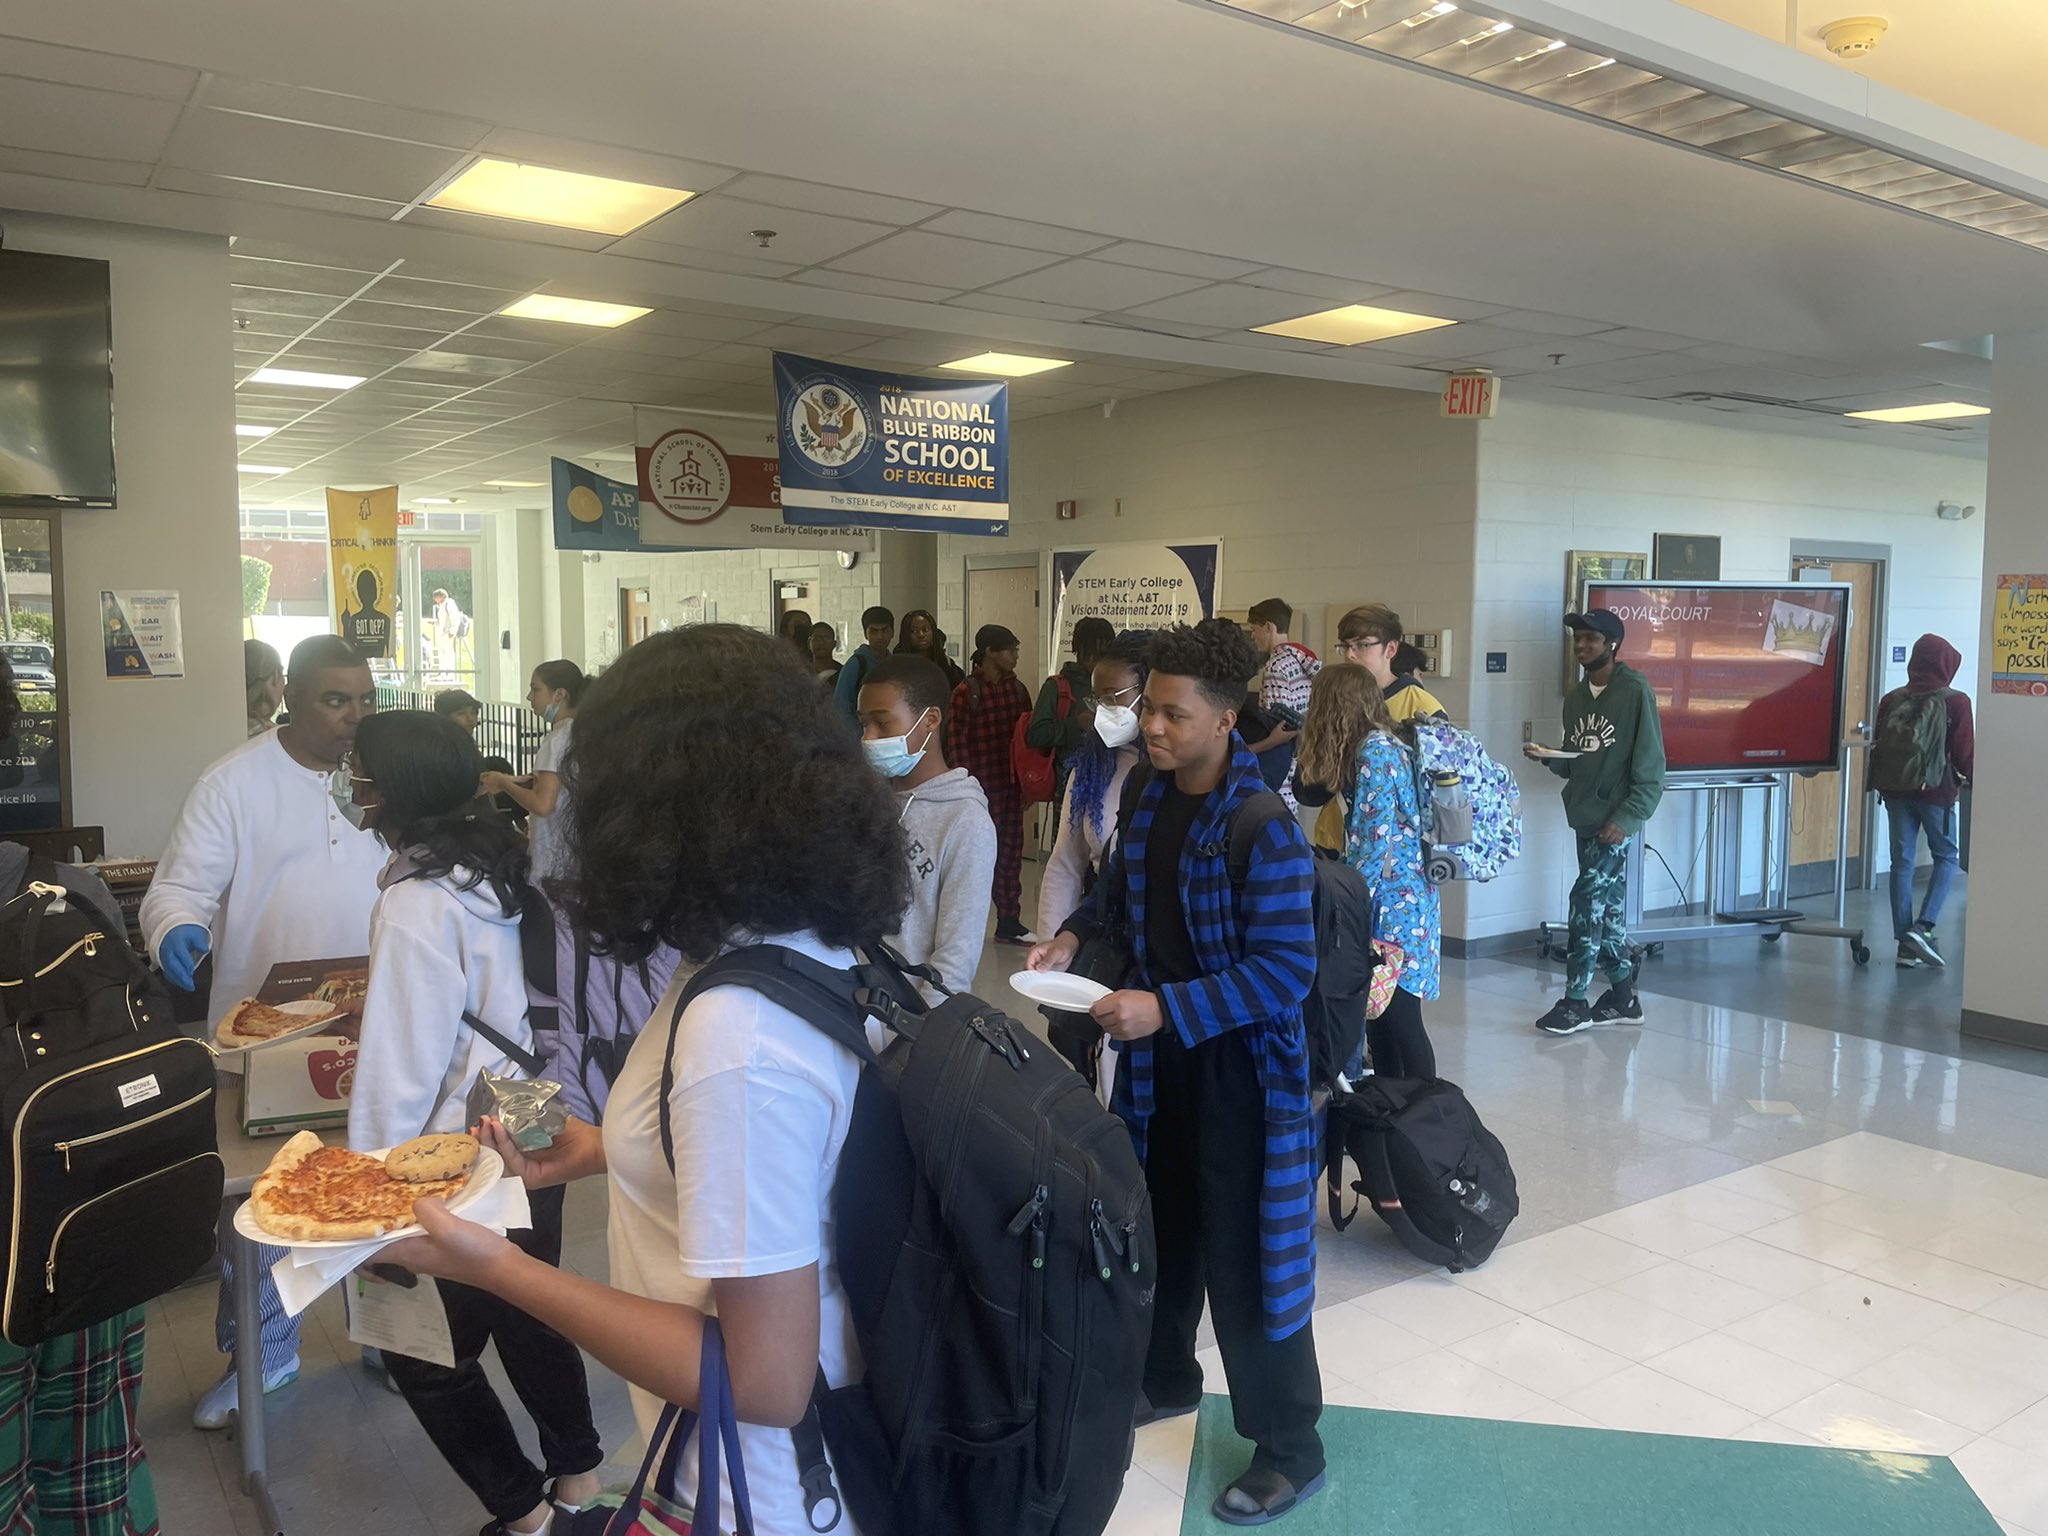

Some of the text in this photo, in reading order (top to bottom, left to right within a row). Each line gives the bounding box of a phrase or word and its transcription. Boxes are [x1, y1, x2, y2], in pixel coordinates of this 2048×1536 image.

[880, 384, 902, 394] 2018
[1448, 378, 1487, 414] EXIT
[880, 394, 995, 424] NATIONAL
[883, 418, 995, 444] BLUE RIBBON
[884, 439, 995, 472] SCHOOL
[655, 450, 668, 489] NATIONAL
[667, 439, 694, 451] SCHOOL
[706, 448, 725, 492] CHARACTER
[763, 462, 780, 472] 201
[883, 468, 995, 489] OF EXCELLENCE
[611, 491, 635, 508] AP
[830, 495, 845, 505] The
[847, 497, 868, 507] STEM
[870, 498, 888, 510] Early
[889, 500, 916, 511] College
[917, 503, 924, 511] at
[942, 504, 957, 512] A&T
[614, 511, 640, 530] Dip
[750, 524, 870, 537] Stem Early College at NC A&T
[331, 537, 396, 547] CRITICAL HINKIN
[1078, 577, 1183, 590] STEM Early College
[1098, 593, 1159, 603] at N.C. A&T
[1071, 604, 1098, 616] Vision
[1101, 604, 1148, 616] Statement
[1661, 606, 1713, 621] COURT
[356, 619, 385, 636] GOT QEP?
[2003, 622, 2048, 634] the word
[1997, 639, 2019, 650] says
[149, 652, 176, 660] WASH
[22, 793, 37, 803] 116
[907, 840, 935, 880] ER
[105, 868, 122, 878] THE
[122, 866, 153, 876] ITALIAN
